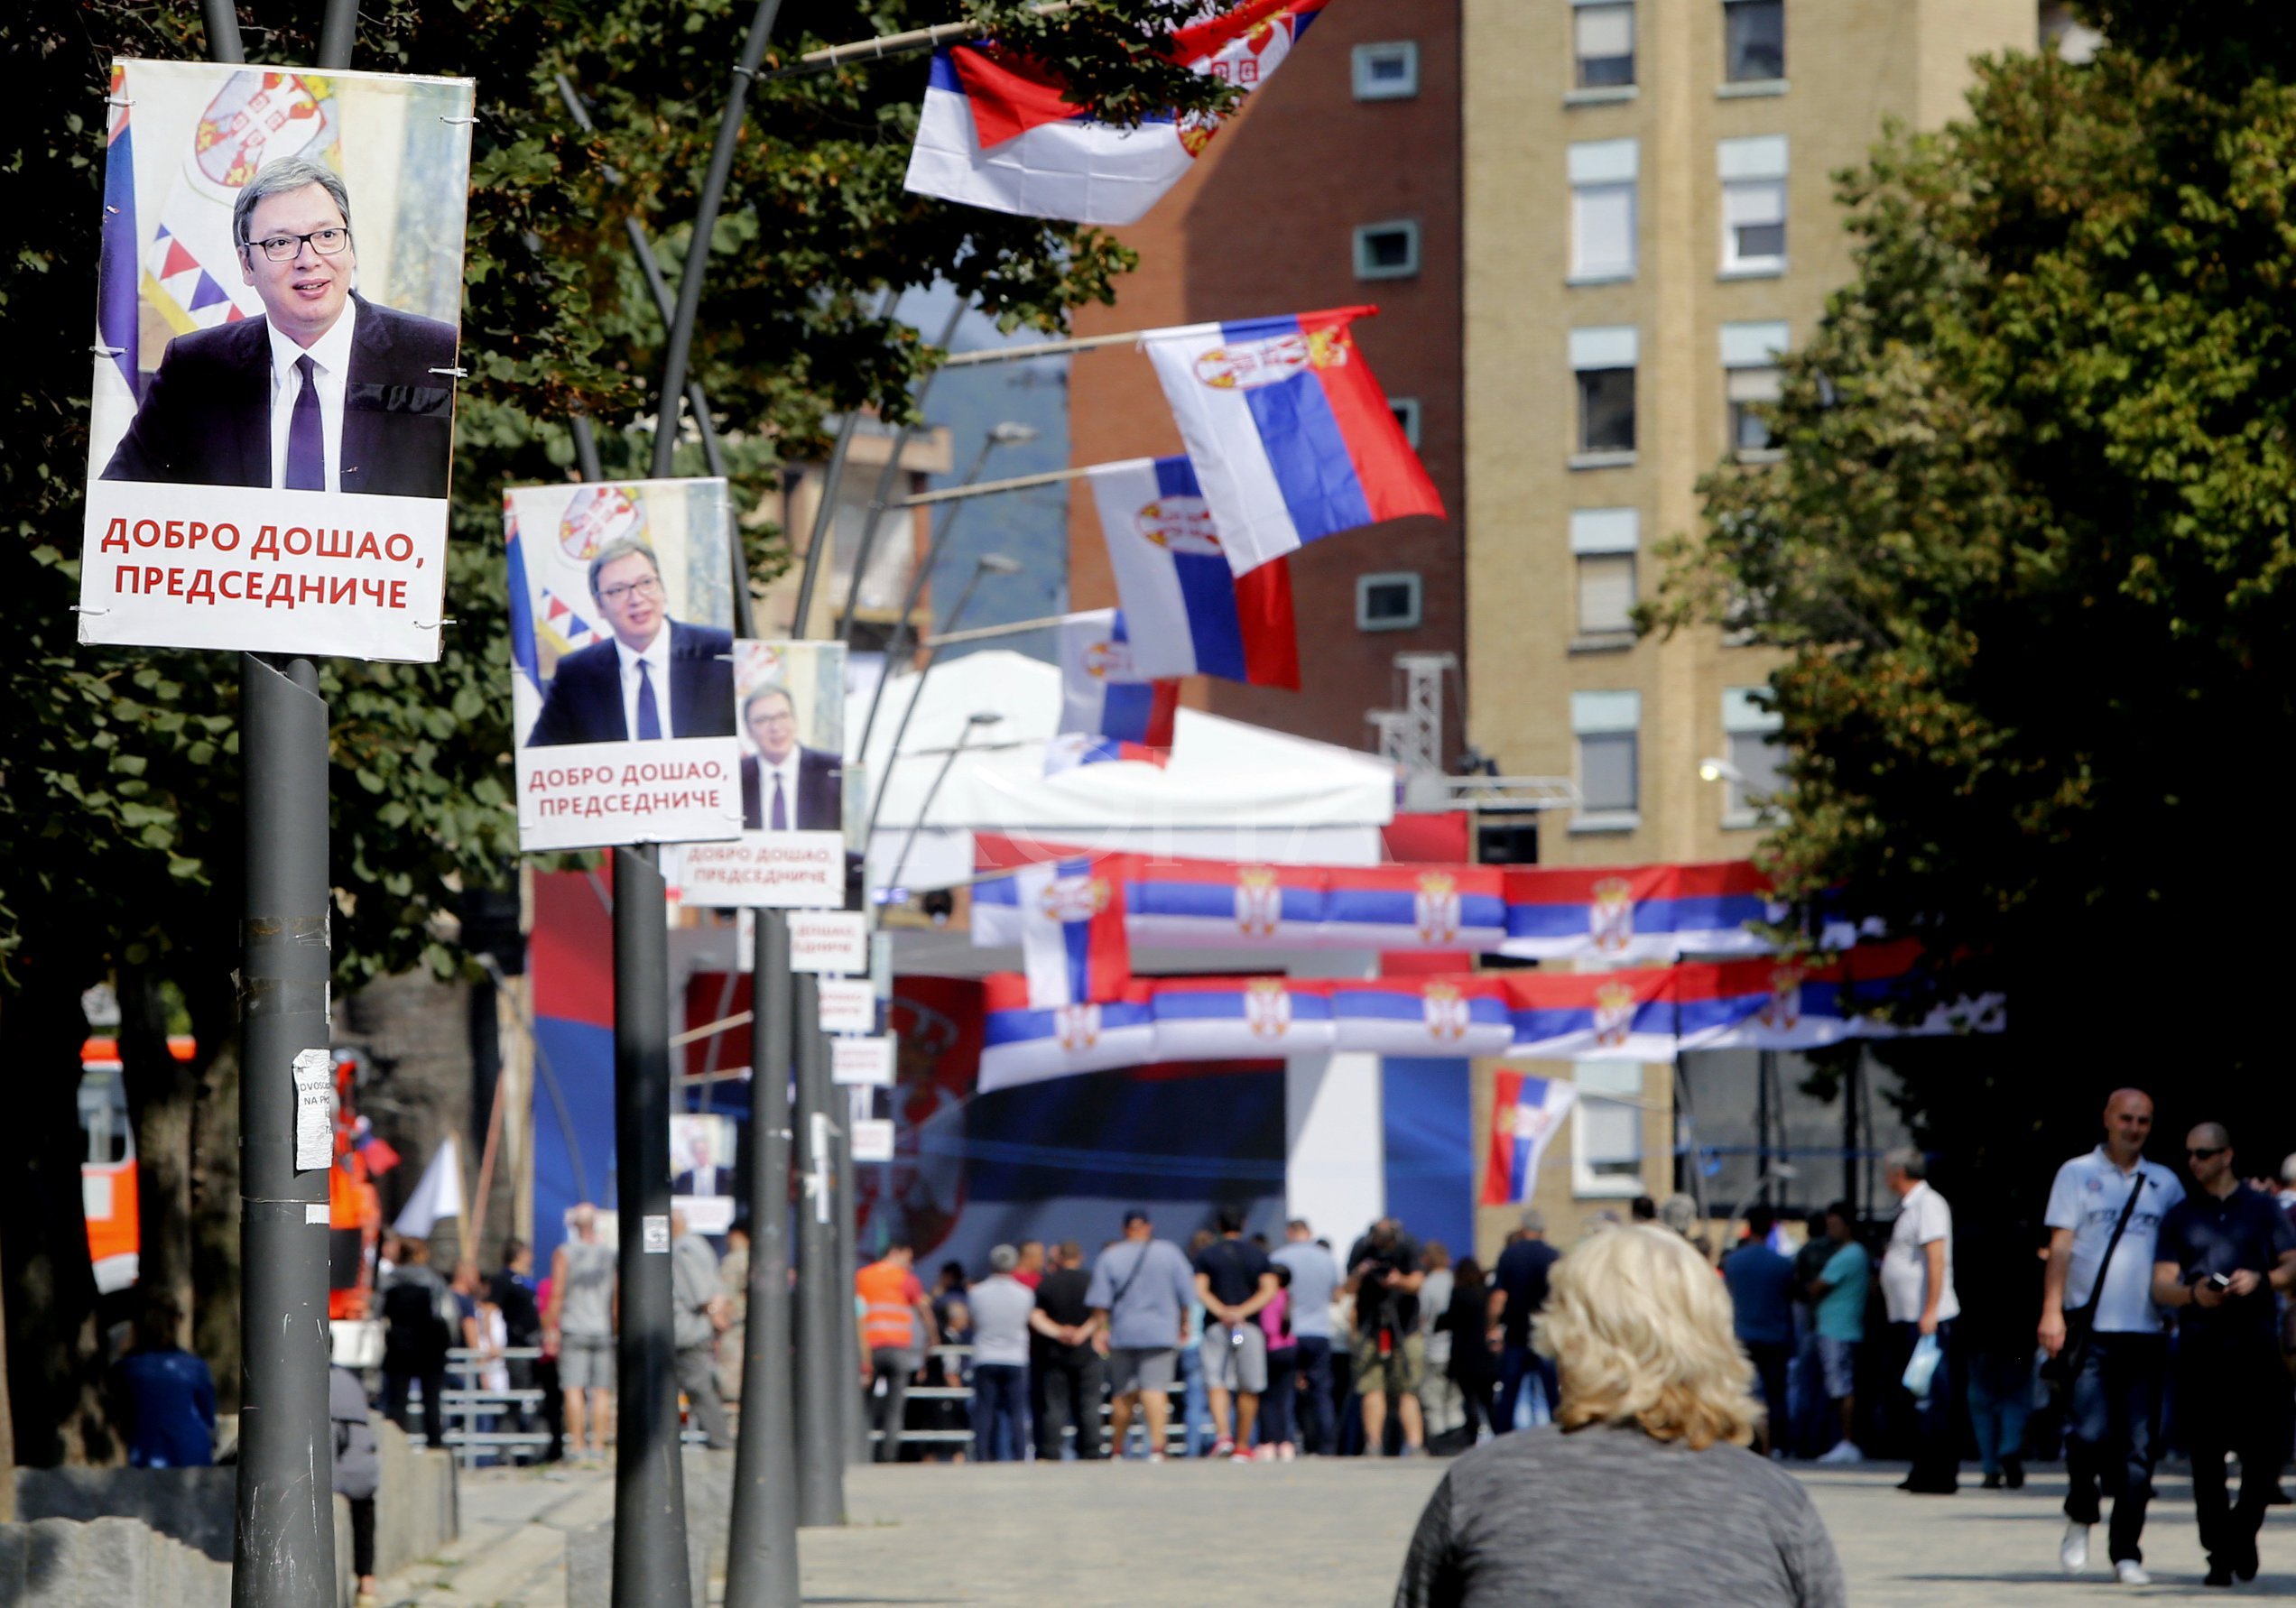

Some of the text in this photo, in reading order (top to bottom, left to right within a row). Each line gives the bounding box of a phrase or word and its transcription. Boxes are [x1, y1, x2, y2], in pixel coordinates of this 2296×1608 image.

[100, 517, 424, 569] ДОБРО ДОШАО,
[115, 565, 408, 609] ПРЕДСЕДНИЧЕ
[529, 761, 728, 793] ДОБРО ДОШАО,
[540, 790, 721, 818] ПРЕДСЕДНИЧЕ
[687, 846, 753, 864] ДОБРО
[693, 866, 828, 885] ПРЕДСЕДНИЧЕ
